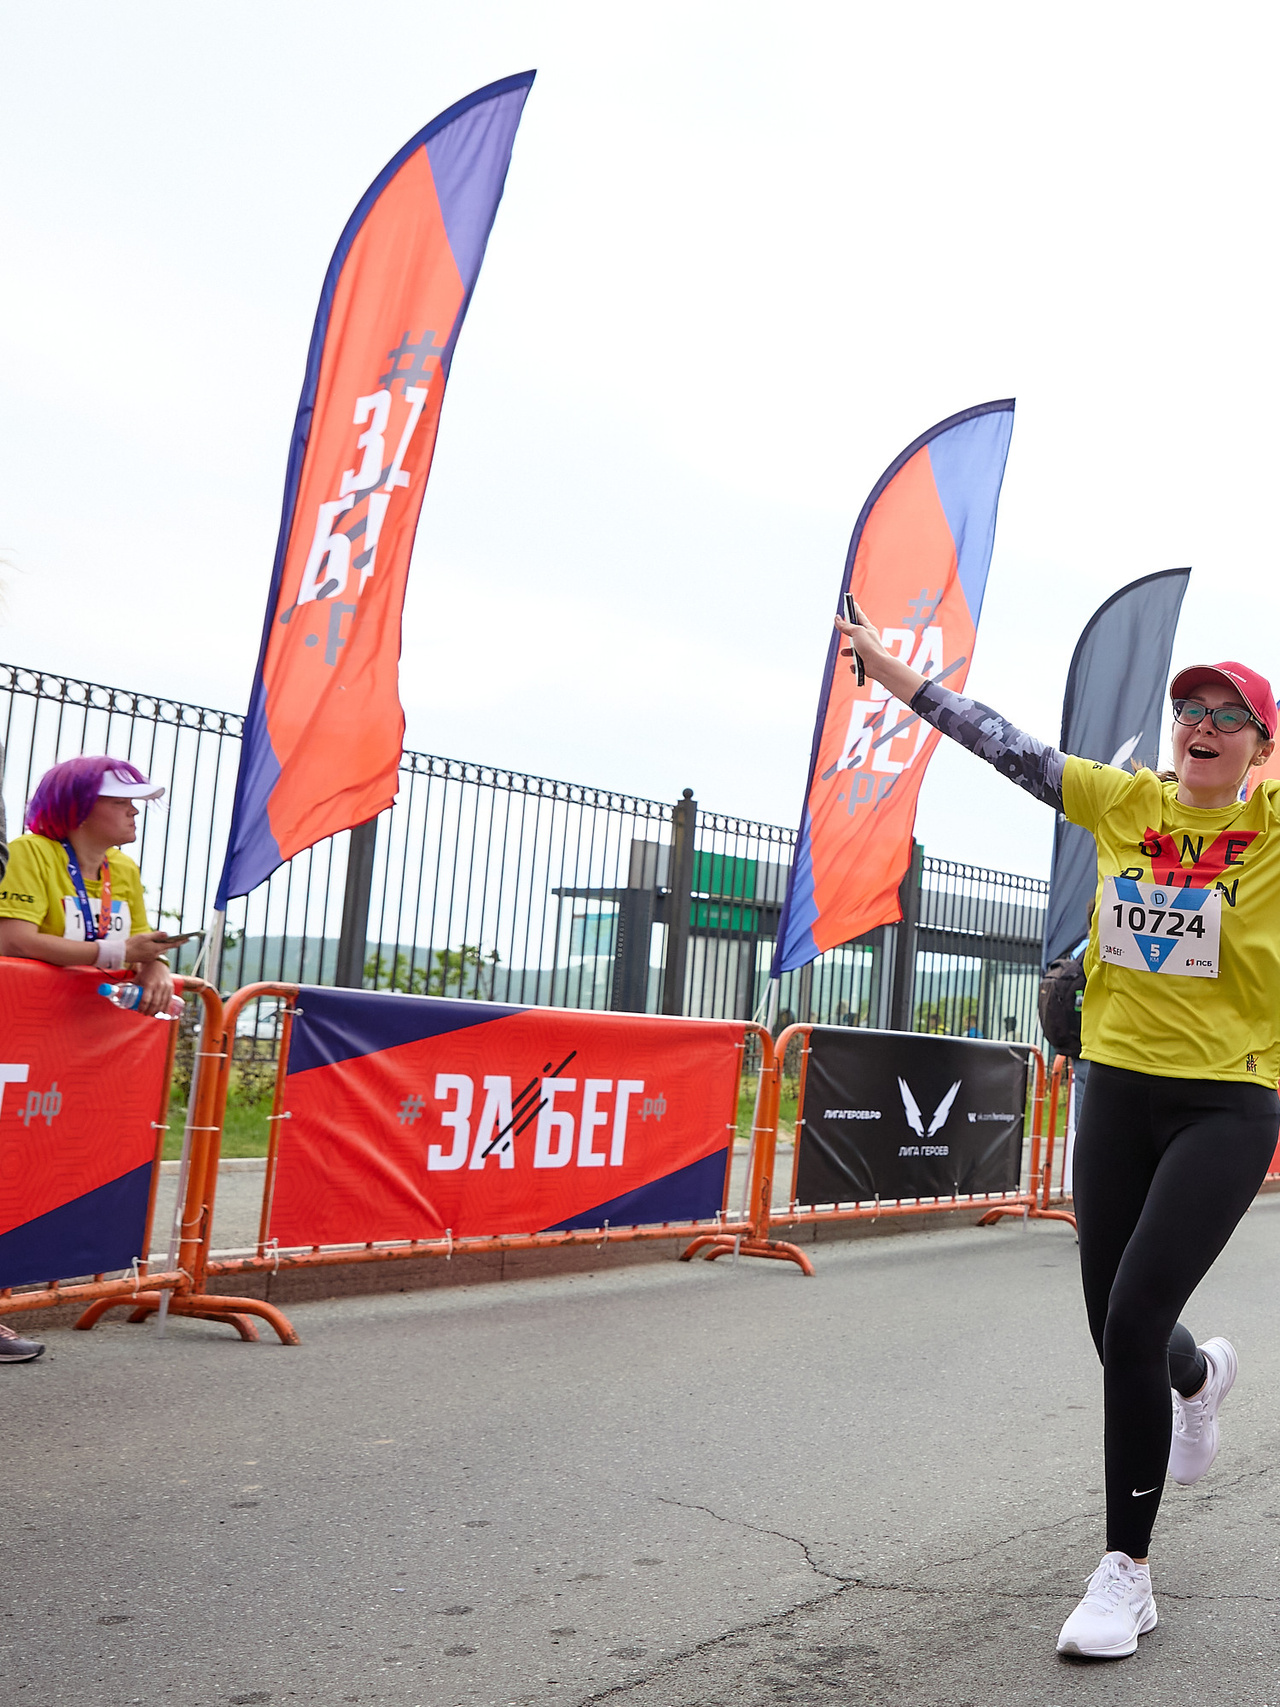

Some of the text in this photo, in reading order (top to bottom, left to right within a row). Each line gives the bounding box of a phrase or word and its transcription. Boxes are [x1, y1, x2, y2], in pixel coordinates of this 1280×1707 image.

[1154, 893, 1165, 904] D
[1113, 904, 1206, 938] 10724
[1150, 944, 1160, 957] 5
[898, 1145, 950, 1157] ЛИГА ГЕРОЕВ
